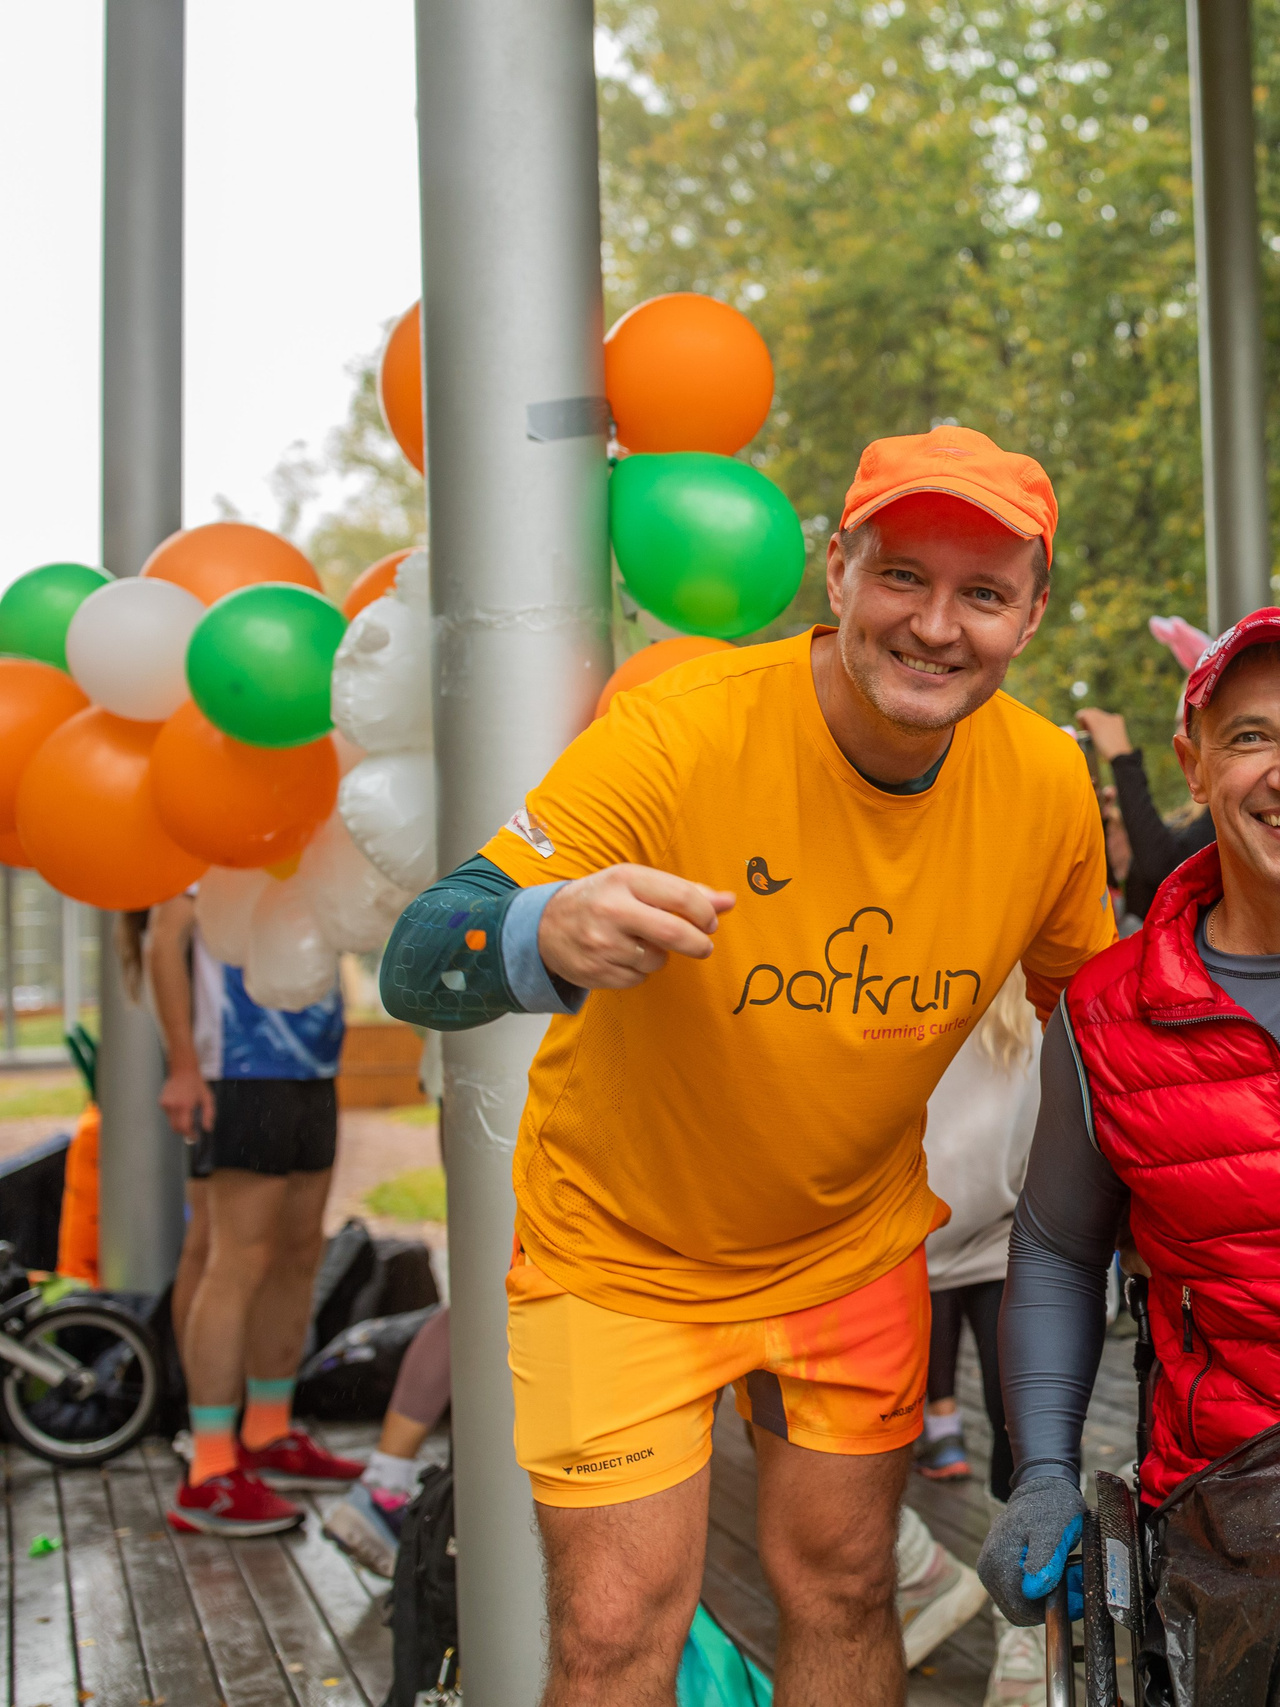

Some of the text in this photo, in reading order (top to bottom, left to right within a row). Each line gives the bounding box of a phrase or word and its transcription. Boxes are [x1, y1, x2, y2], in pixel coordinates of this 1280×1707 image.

[732, 907, 981, 1015] parkrun
[863, 1024, 925, 1041] running
[576, 1447, 655, 1475] PROJECT ROCK
